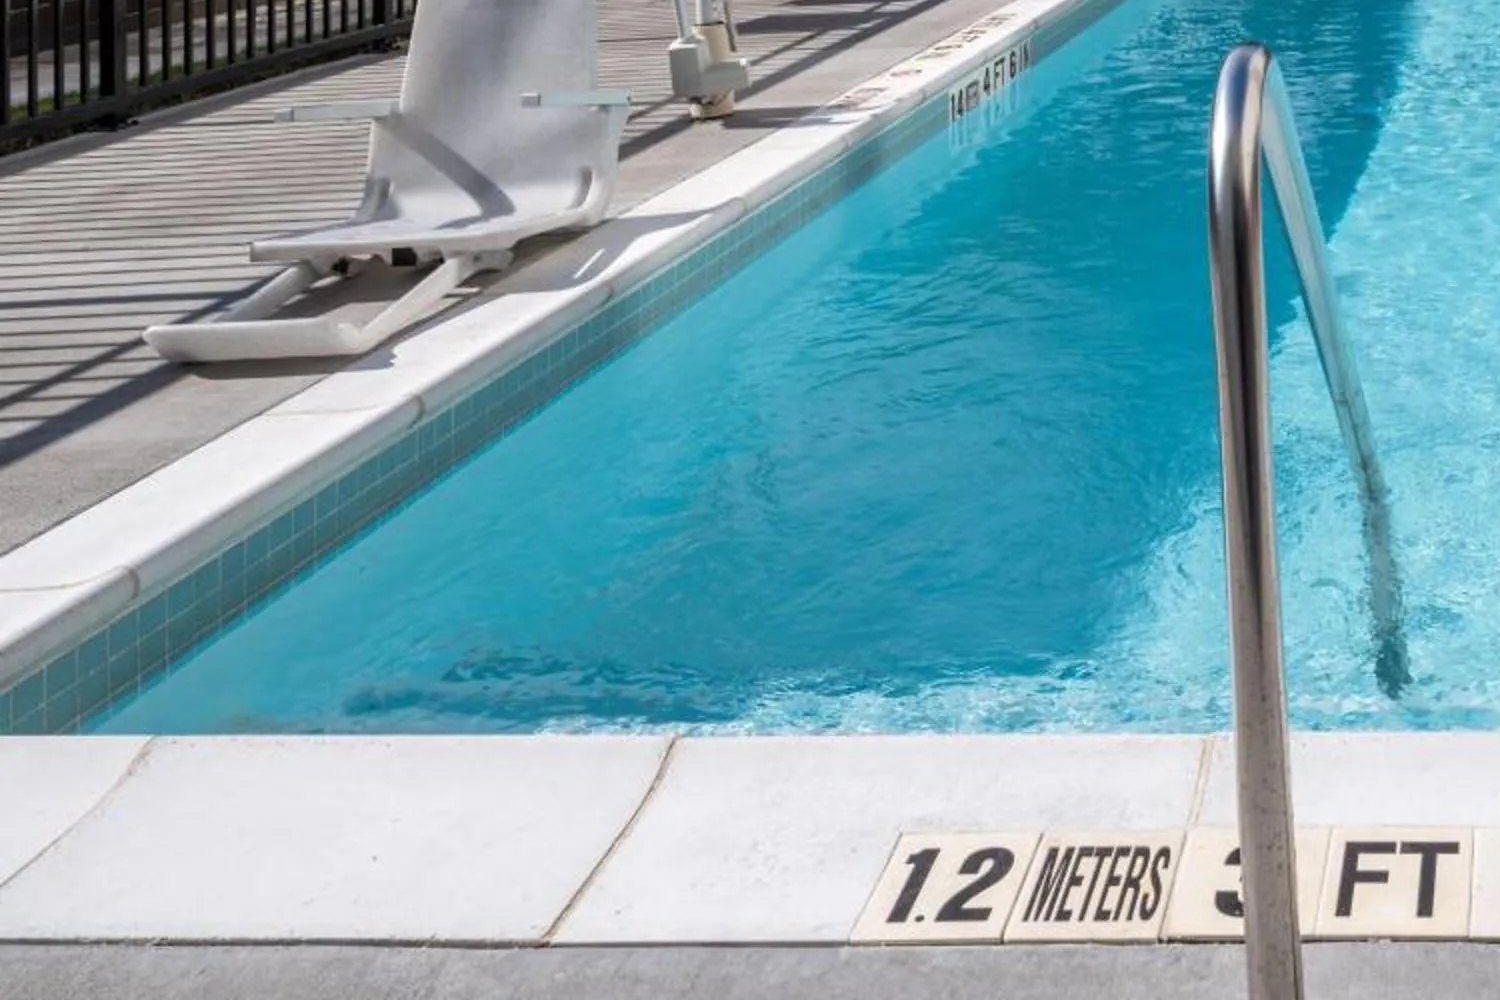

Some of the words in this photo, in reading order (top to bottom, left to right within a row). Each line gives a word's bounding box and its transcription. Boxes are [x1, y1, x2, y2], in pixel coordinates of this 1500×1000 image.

[983, 67, 991, 95] 4
[994, 57, 1005, 88] FT
[1009, 50, 1017, 79] 6
[886, 846, 1015, 923] 1.2
[1022, 846, 1171, 922] METERS
[1335, 841, 1460, 917] FT
